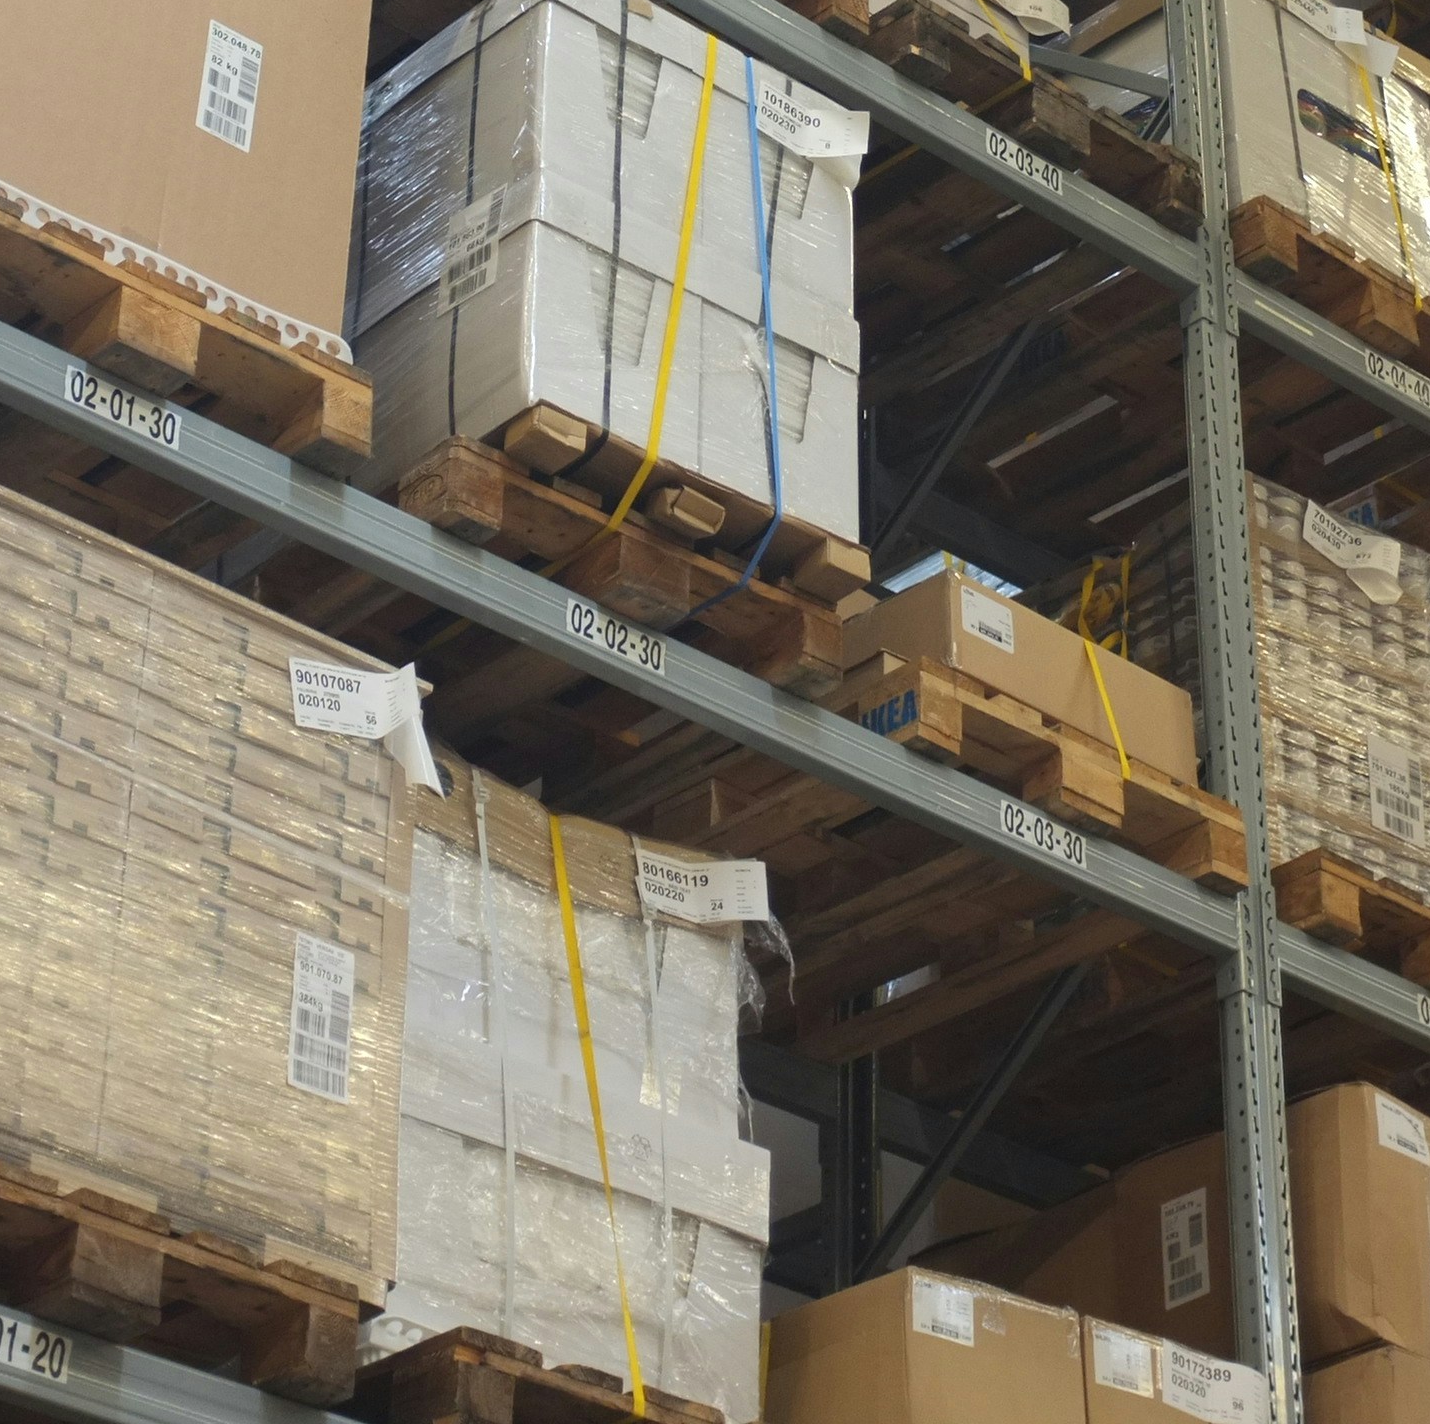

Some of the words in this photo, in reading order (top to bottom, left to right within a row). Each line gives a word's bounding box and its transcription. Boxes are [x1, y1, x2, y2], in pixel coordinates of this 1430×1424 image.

[211, 28, 261, 59] 302.048.78
[211, 54, 223, 67] 82
[226, 62, 238, 76] kg
[760, 105, 796, 135] 020230
[764, 89, 821, 128] 10186390
[990, 132, 1059, 192] 02-03-40
[1368, 352, 1430, 407] 02-04-40
[71, 371, 175, 445] 02-01-30
[1312, 524, 1341, 550] 020430
[1314, 509, 1362, 546] 70192736
[571, 603, 662, 671] 02-02-30
[295, 669, 361, 694] 90107087
[298, 693, 341, 712] 020120
[365, 714, 377, 725] 56
[1004, 803, 1082, 865] 02-03-30
[642, 861, 709, 888] 80166119
[644, 881, 685, 903] 020220
[711, 902, 724, 911] 24
[300, 960, 343, 985] 901.070.87
[1171, 1351, 1232, 1383] 90172389
[1171, 1373, 1206, 1398] 020320
